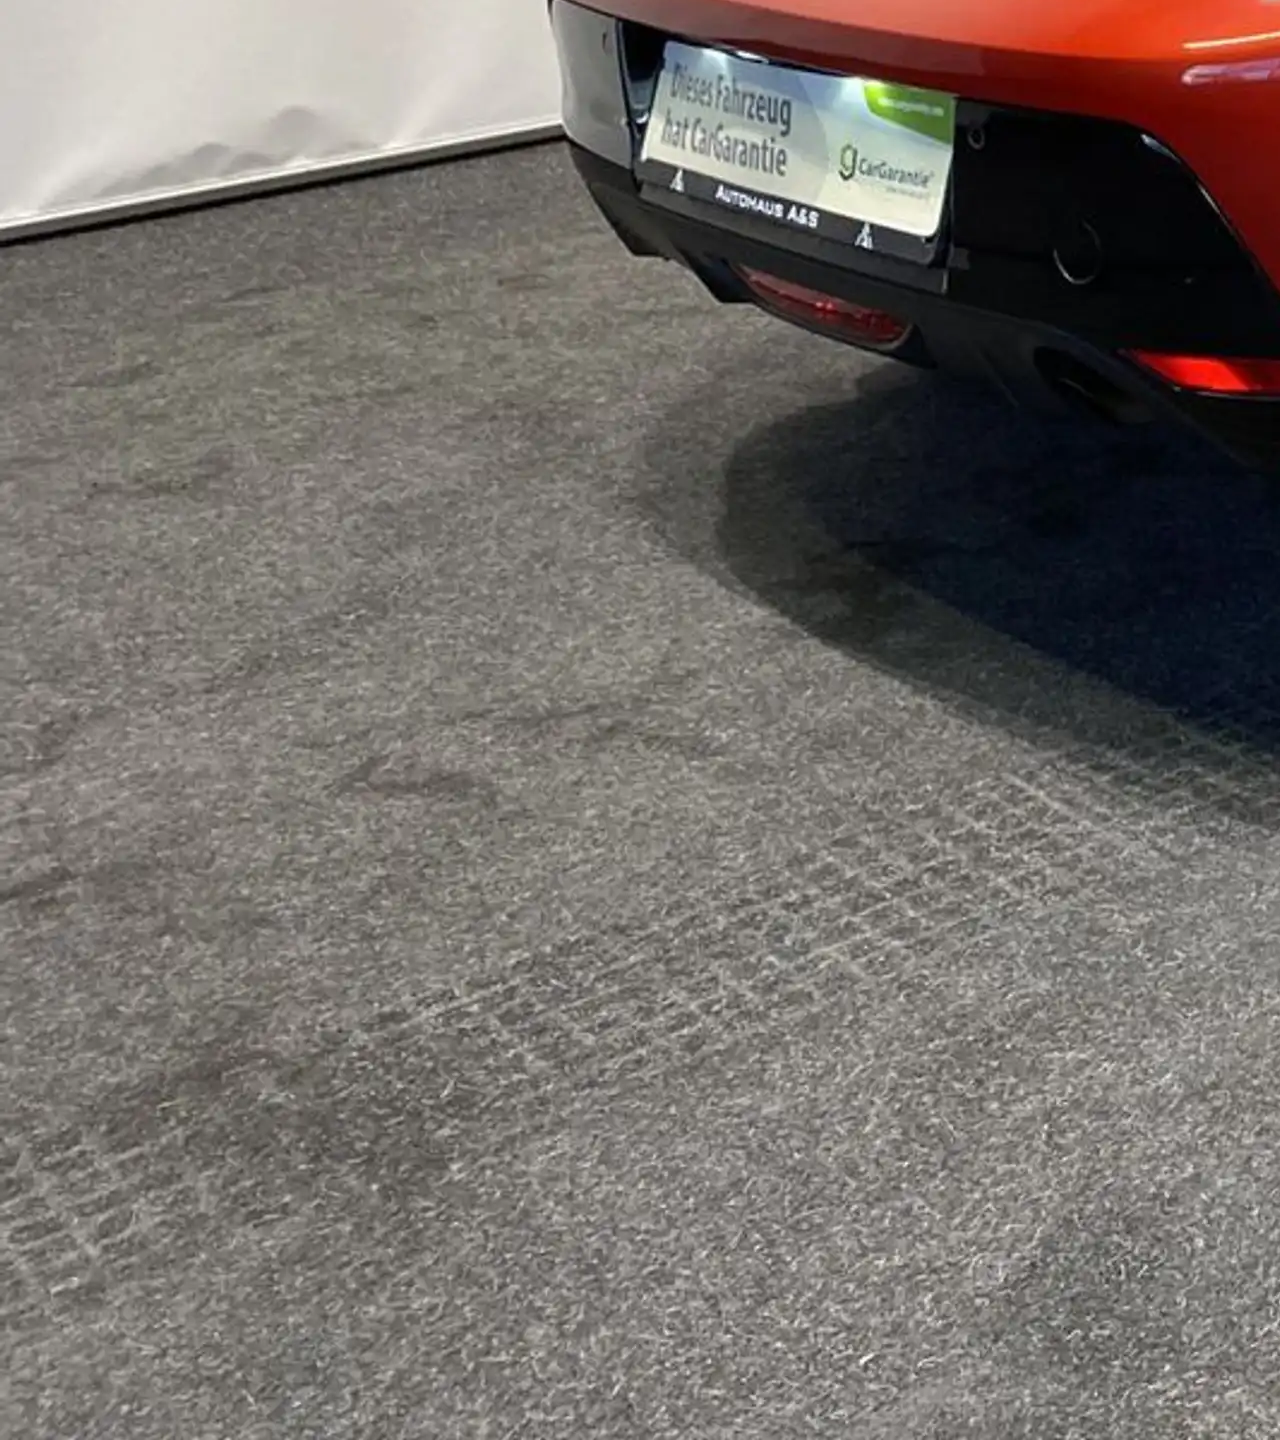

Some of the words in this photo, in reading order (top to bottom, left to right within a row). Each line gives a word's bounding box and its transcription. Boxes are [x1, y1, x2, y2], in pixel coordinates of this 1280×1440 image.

[714, 73, 792, 137] Fahrzeug
[660, 107, 689, 151] hat
[690, 116, 788, 177] CarGarantie
[714, 183, 785, 218] AUTOHAUS
[786, 204, 821, 229] A&S
